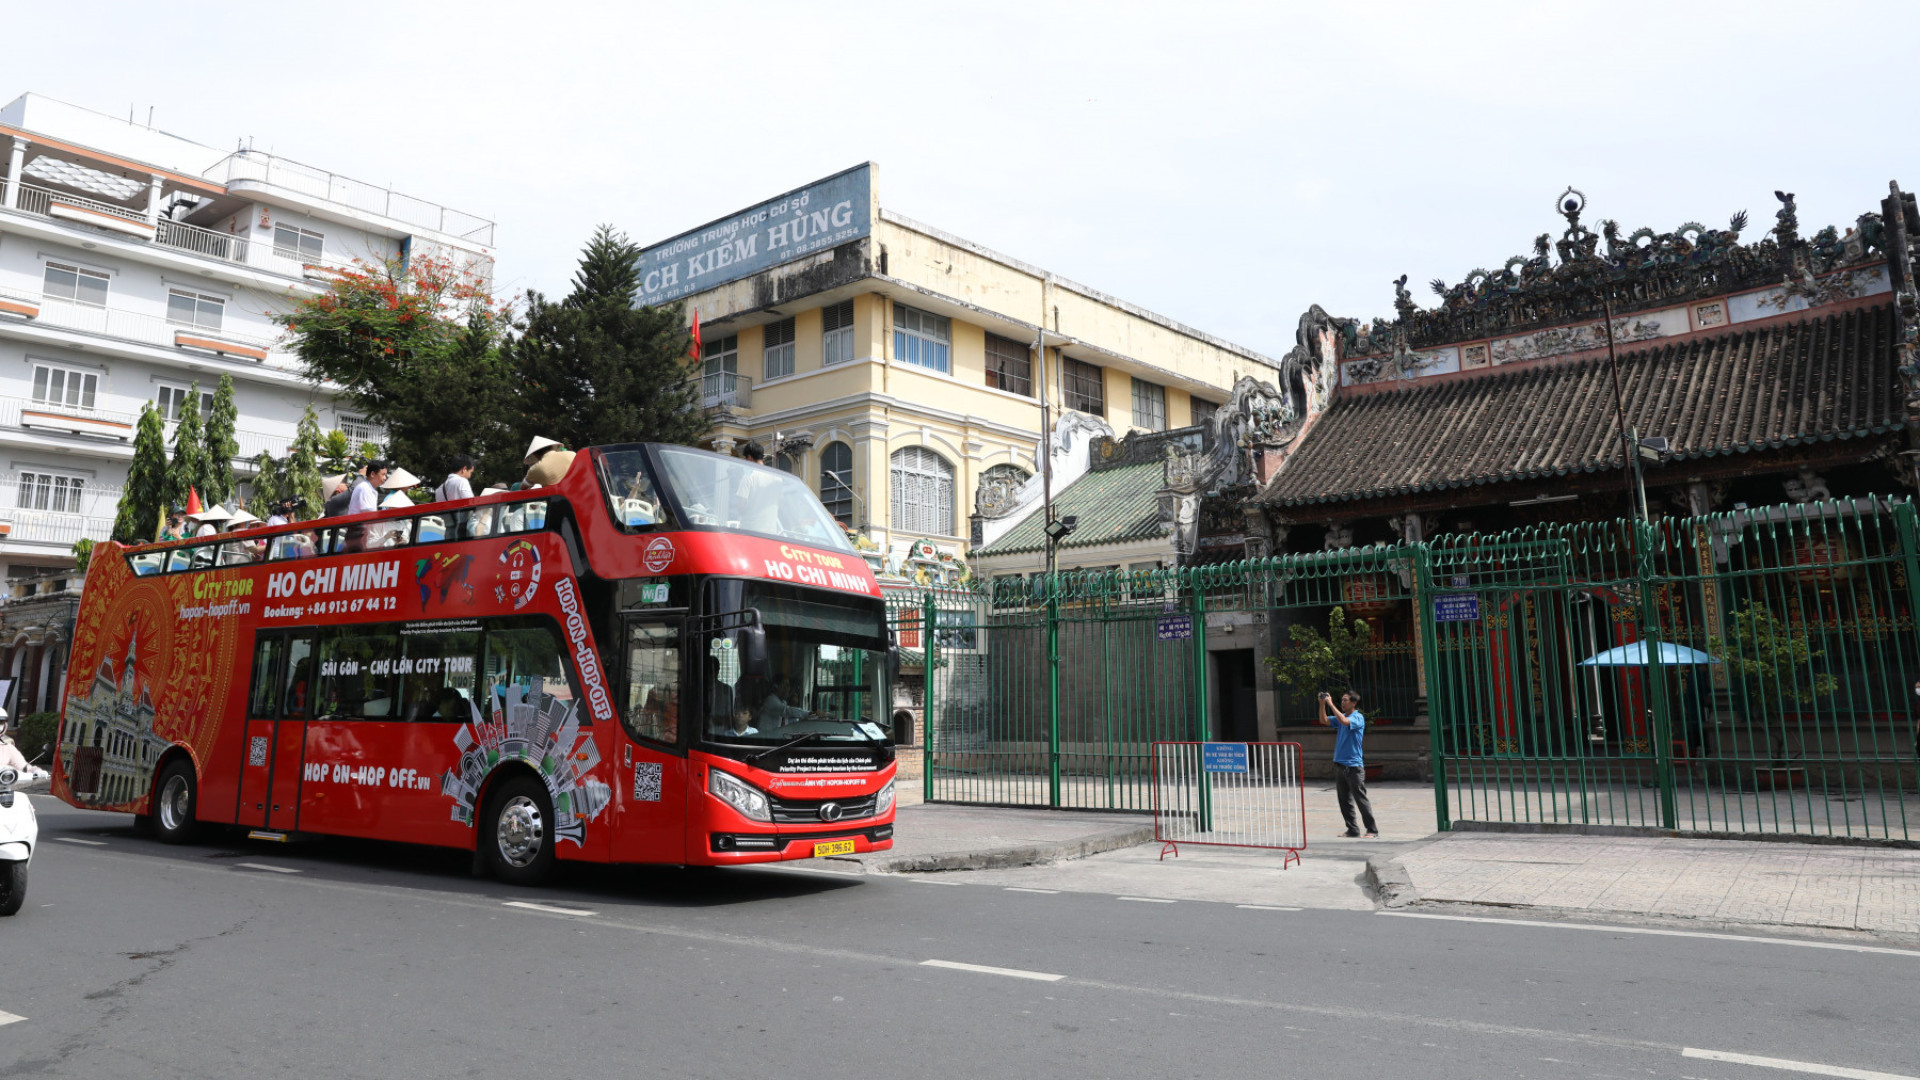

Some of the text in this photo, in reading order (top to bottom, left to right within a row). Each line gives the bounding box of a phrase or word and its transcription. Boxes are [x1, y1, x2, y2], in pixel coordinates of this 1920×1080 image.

[656, 238, 698, 261] TRƯỜNG
[702, 221, 738, 243] TRUNG
[742, 207, 767, 231] HỌC
[770, 200, 788, 217] CƠ
[686, 232, 758, 280] KIẾM
[767, 200, 853, 251] HÙNG
[780, 545, 844, 570] CITY TOUR
[193, 573, 254, 599] CITY TOUR
[266, 560, 400, 598] HO CHI MINH
[764, 559, 870, 594] HO CHI MINH
[179, 599, 250, 622] hopon-hopoff.vn
[263, 596, 397, 619] Booking: +84 913 67 44 12
[321, 657, 337, 676] SÀI
[339, 657, 359, 675] GÒN
[370, 657, 391, 678] CHỢ
[392, 655, 413, 674] LỚN
[415, 658, 440, 674] CITY
[444, 656, 473, 673] TOUR
[304, 763, 329, 782] HOP
